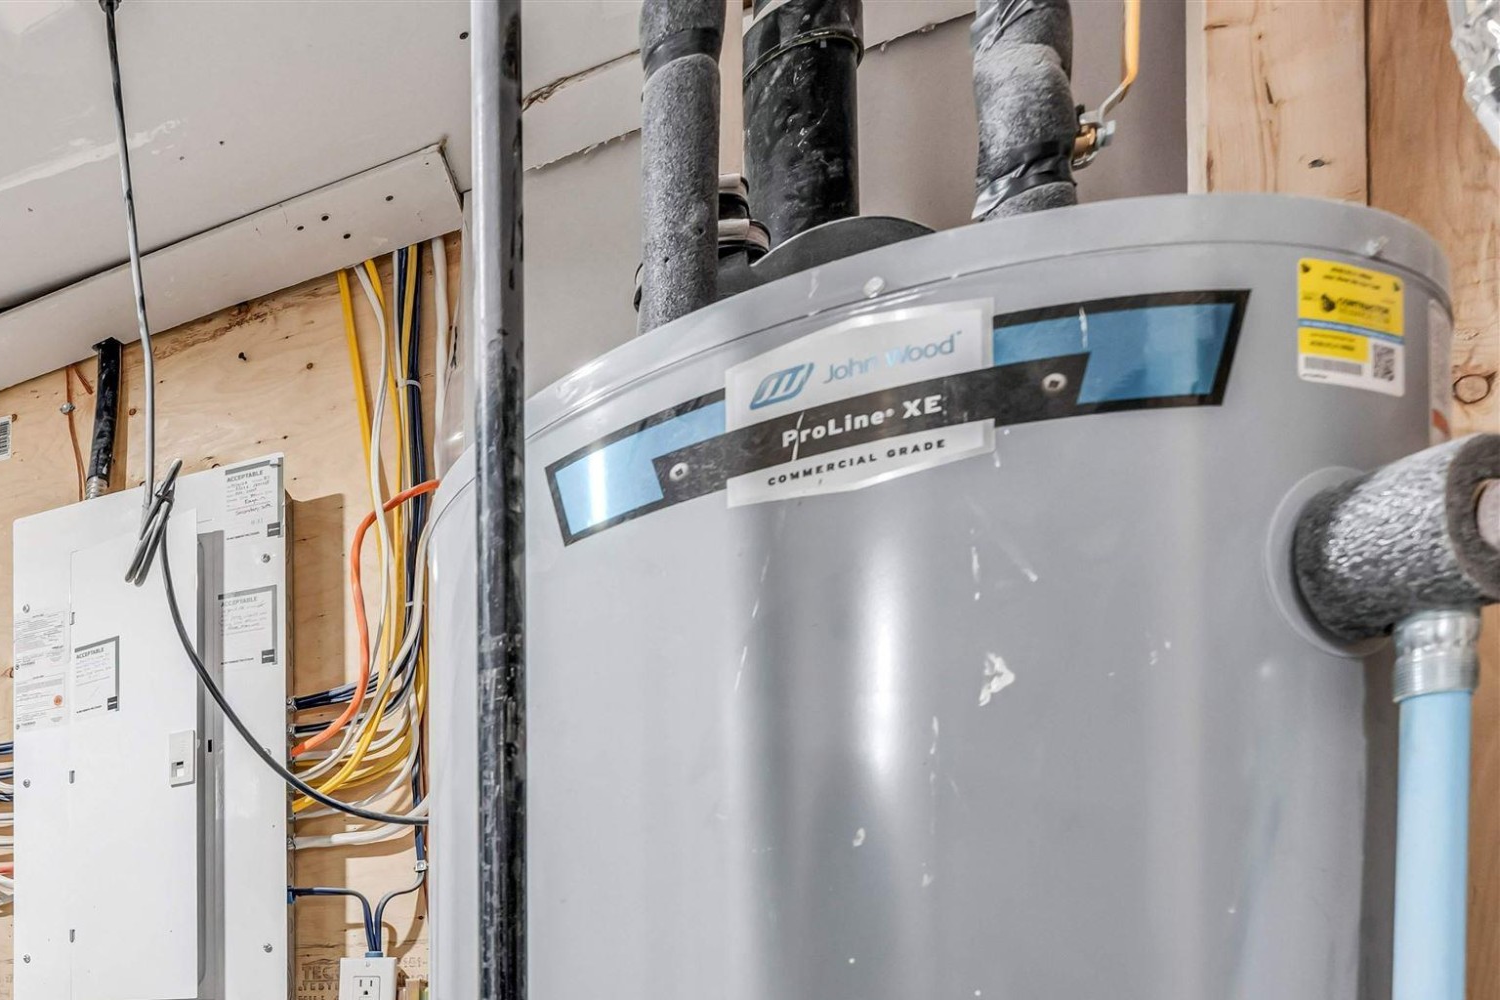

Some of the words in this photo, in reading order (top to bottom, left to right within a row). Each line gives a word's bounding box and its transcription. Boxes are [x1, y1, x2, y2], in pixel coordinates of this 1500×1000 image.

[902, 394, 942, 419] XE
[768, 453, 877, 486] COMMERCIAL
[887, 439, 946, 458] GRADE
[227, 470, 263, 482] ACCEPTABLE
[76, 647, 104, 659] ACCEPTABLE
